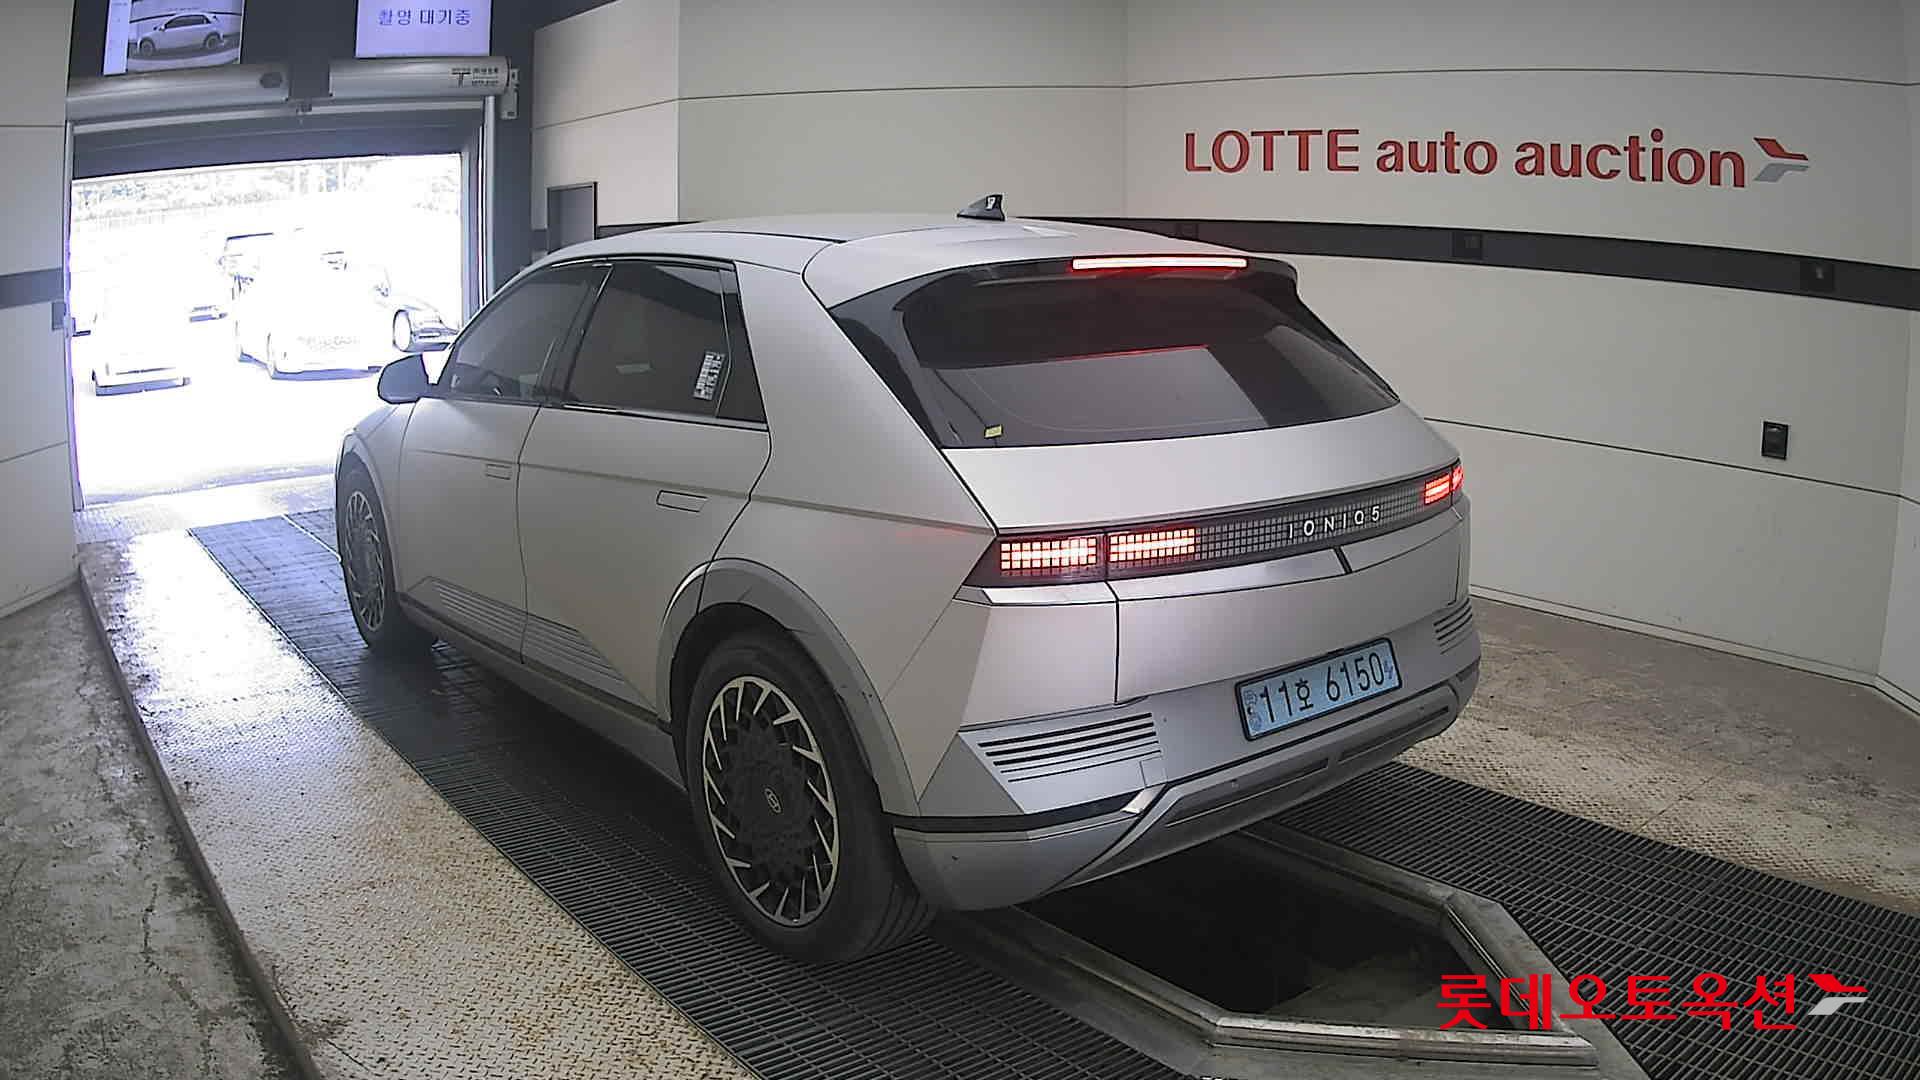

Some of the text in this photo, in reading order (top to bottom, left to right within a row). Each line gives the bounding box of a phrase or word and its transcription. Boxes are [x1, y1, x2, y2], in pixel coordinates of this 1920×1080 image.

[419, 8, 471, 26] 대기중
[1185, 129, 1746, 188] LOTTE auto auction
[1326, 652, 1385, 702] 6150
